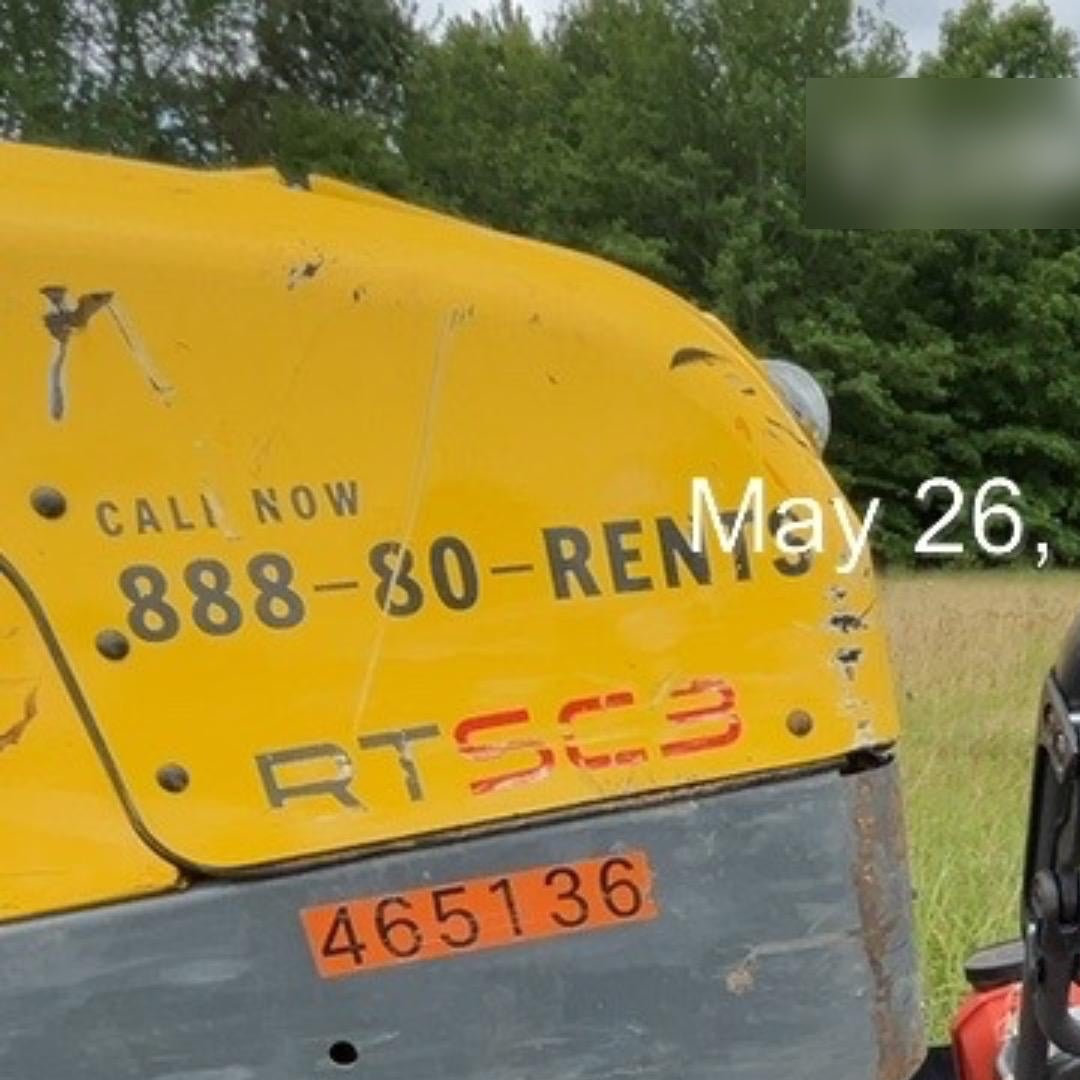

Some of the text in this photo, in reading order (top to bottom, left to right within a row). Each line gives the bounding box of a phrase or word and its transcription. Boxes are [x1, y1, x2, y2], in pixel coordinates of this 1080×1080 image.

[252, 479, 359, 524] NOW
[255, 676, 744, 814] RTSC3
[321, 856, 643, 967] 465136
